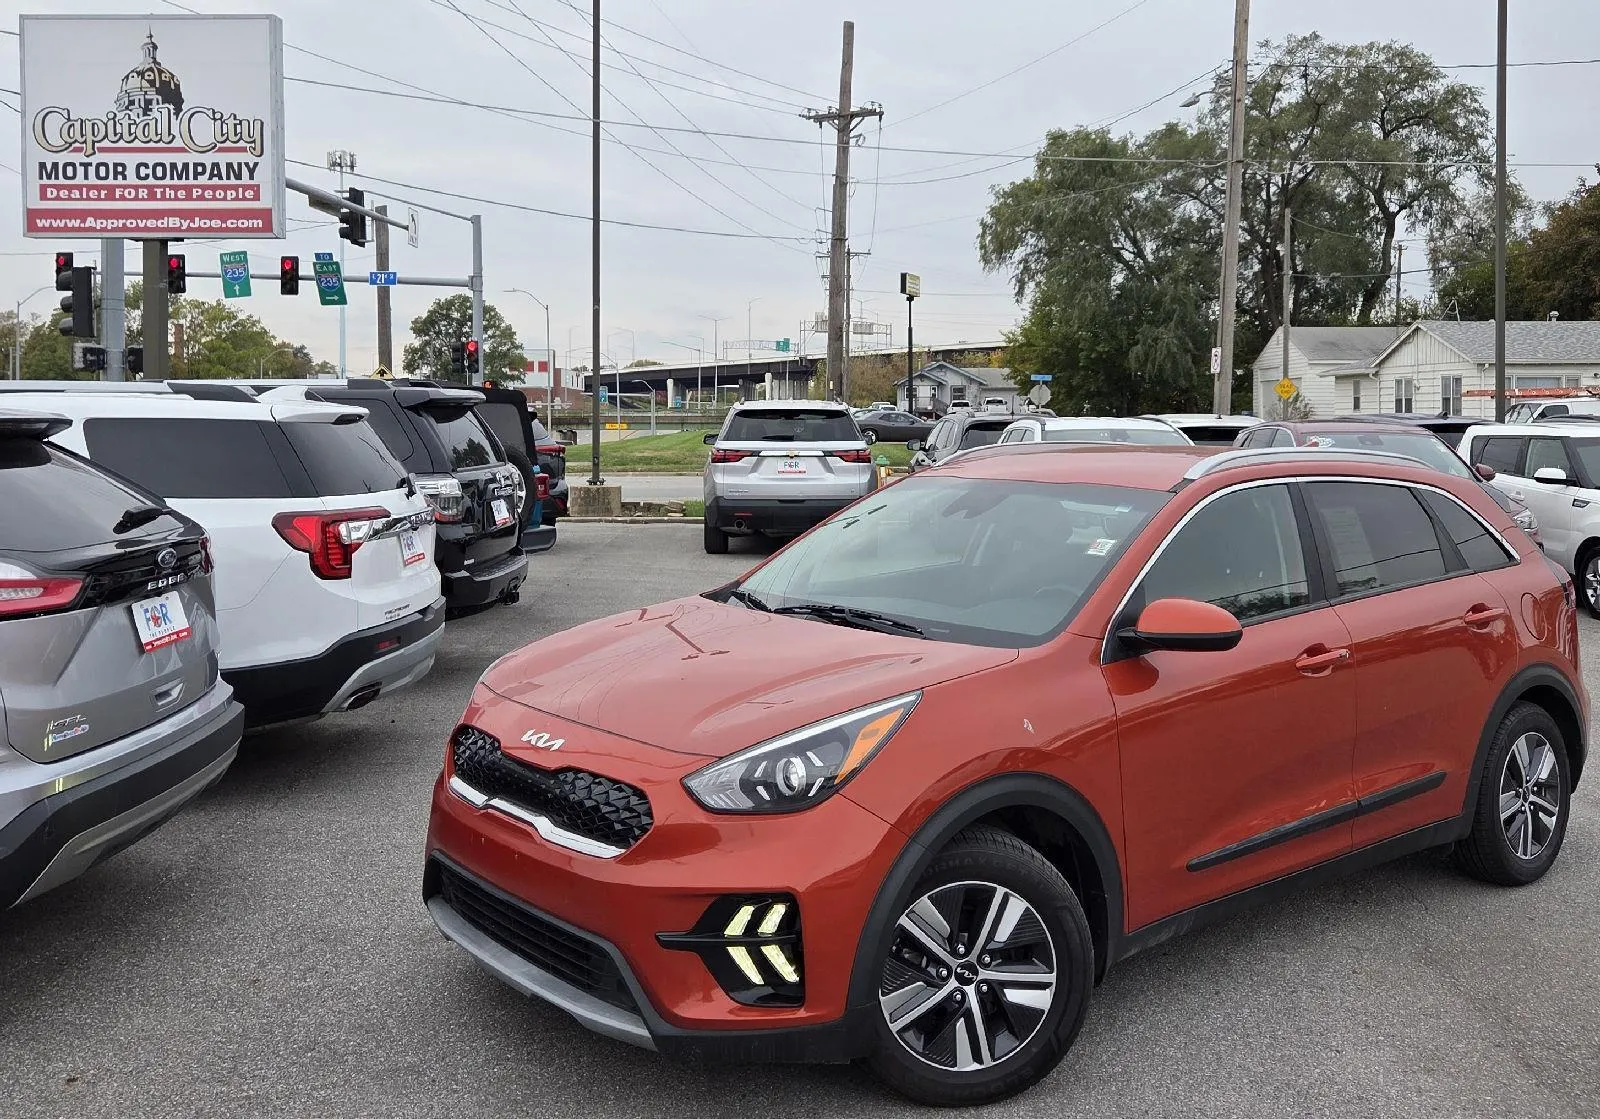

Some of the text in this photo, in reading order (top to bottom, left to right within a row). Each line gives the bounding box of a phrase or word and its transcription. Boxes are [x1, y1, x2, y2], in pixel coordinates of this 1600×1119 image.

[33, 106, 264, 157] Capital City
[38, 161, 260, 181] MOTOR COMPANY
[46, 187, 254, 201] Dealer FOR The People
[36, 216, 263, 229] www.ApprovedByJoe.com
[222, 254, 245, 263] WEST
[226, 268, 245, 278] 235
[316, 263, 337, 271] EAST
[320, 277, 339, 287] 235
[143, 602, 173, 631] FOR
